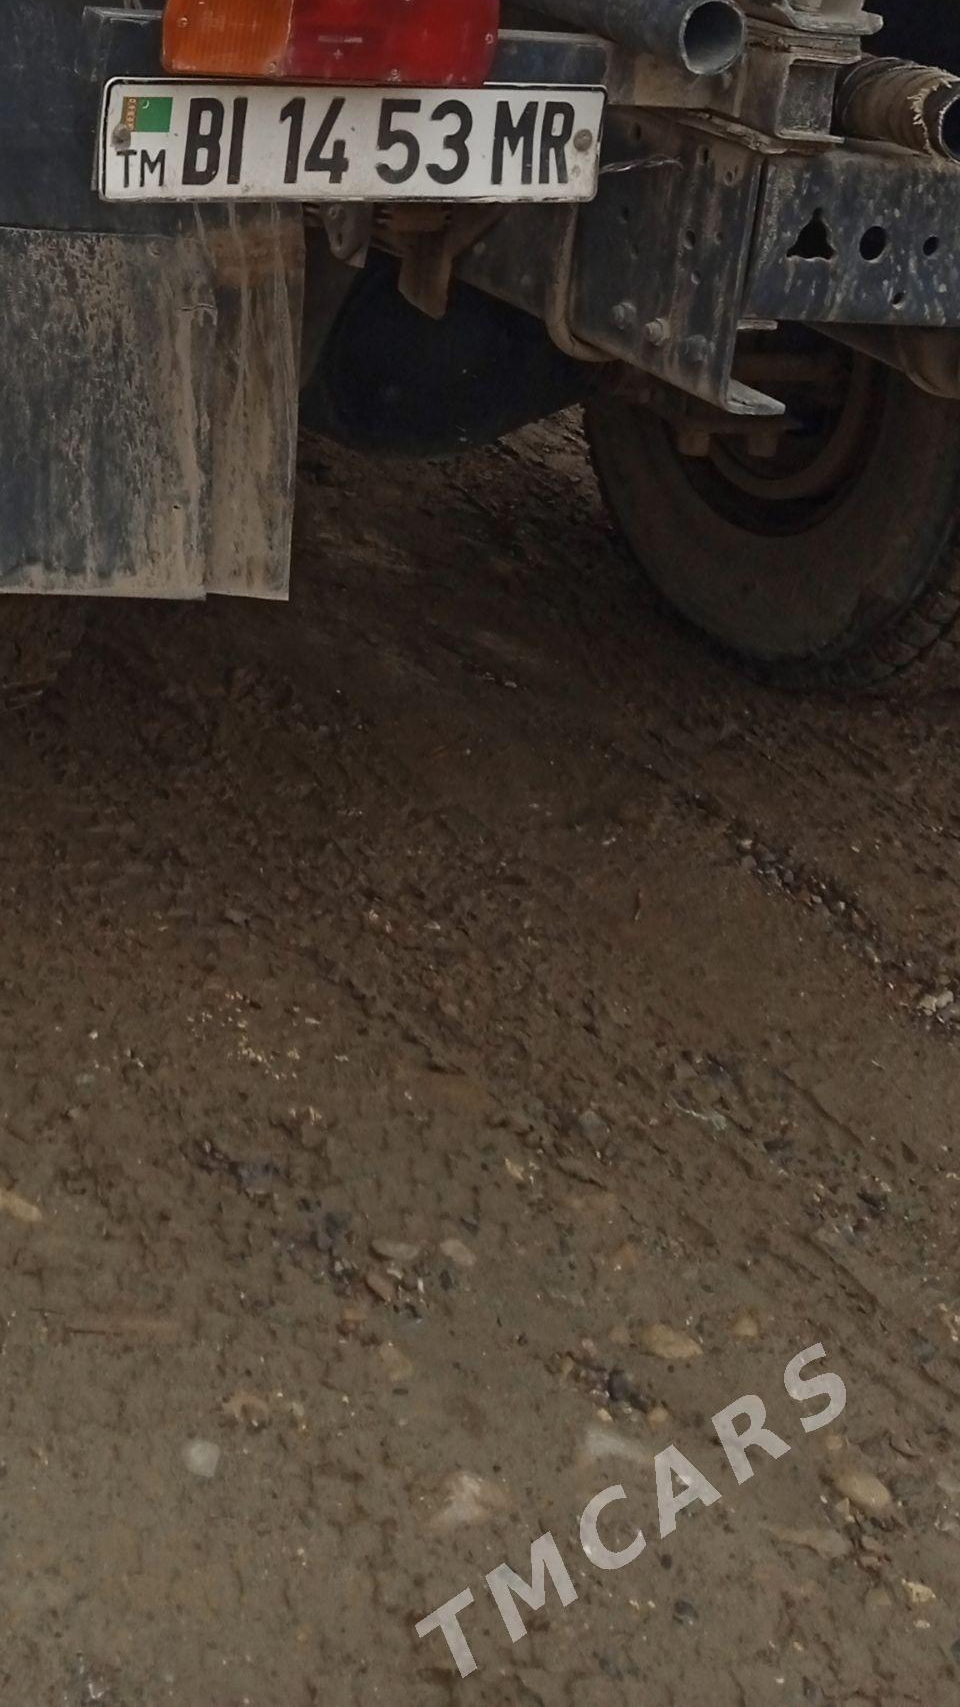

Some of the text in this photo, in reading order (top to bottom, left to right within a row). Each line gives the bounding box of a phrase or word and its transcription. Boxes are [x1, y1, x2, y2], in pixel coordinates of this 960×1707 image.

[115, 148, 167, 188] TM
[181, 97, 576, 186] BI 14 53 MR
